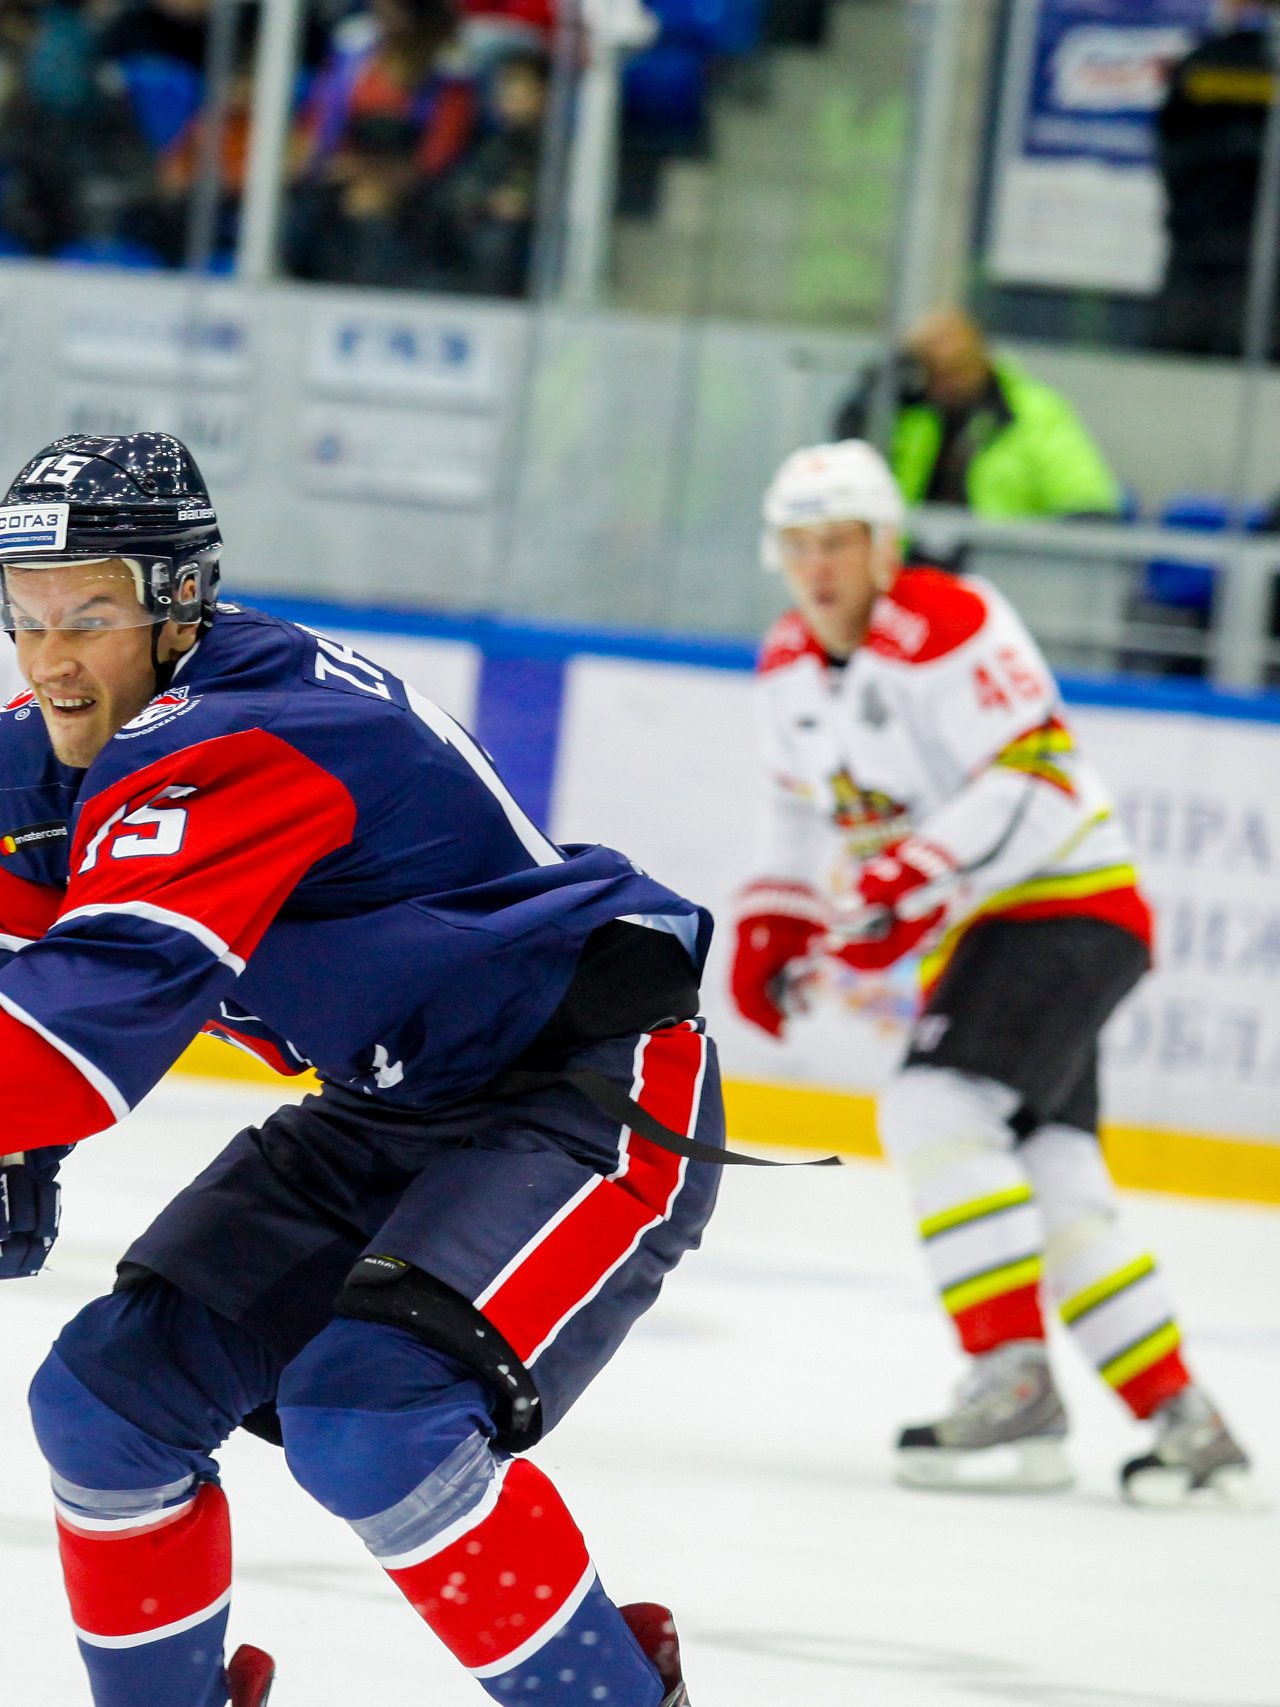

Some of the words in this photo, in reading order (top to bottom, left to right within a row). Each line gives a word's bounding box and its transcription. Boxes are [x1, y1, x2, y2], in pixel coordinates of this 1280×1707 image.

[25, 453, 94, 485] 15
[401, 680, 566, 868] 1
[14, 825, 68, 847] mastercard
[77, 785, 199, 875] 15
